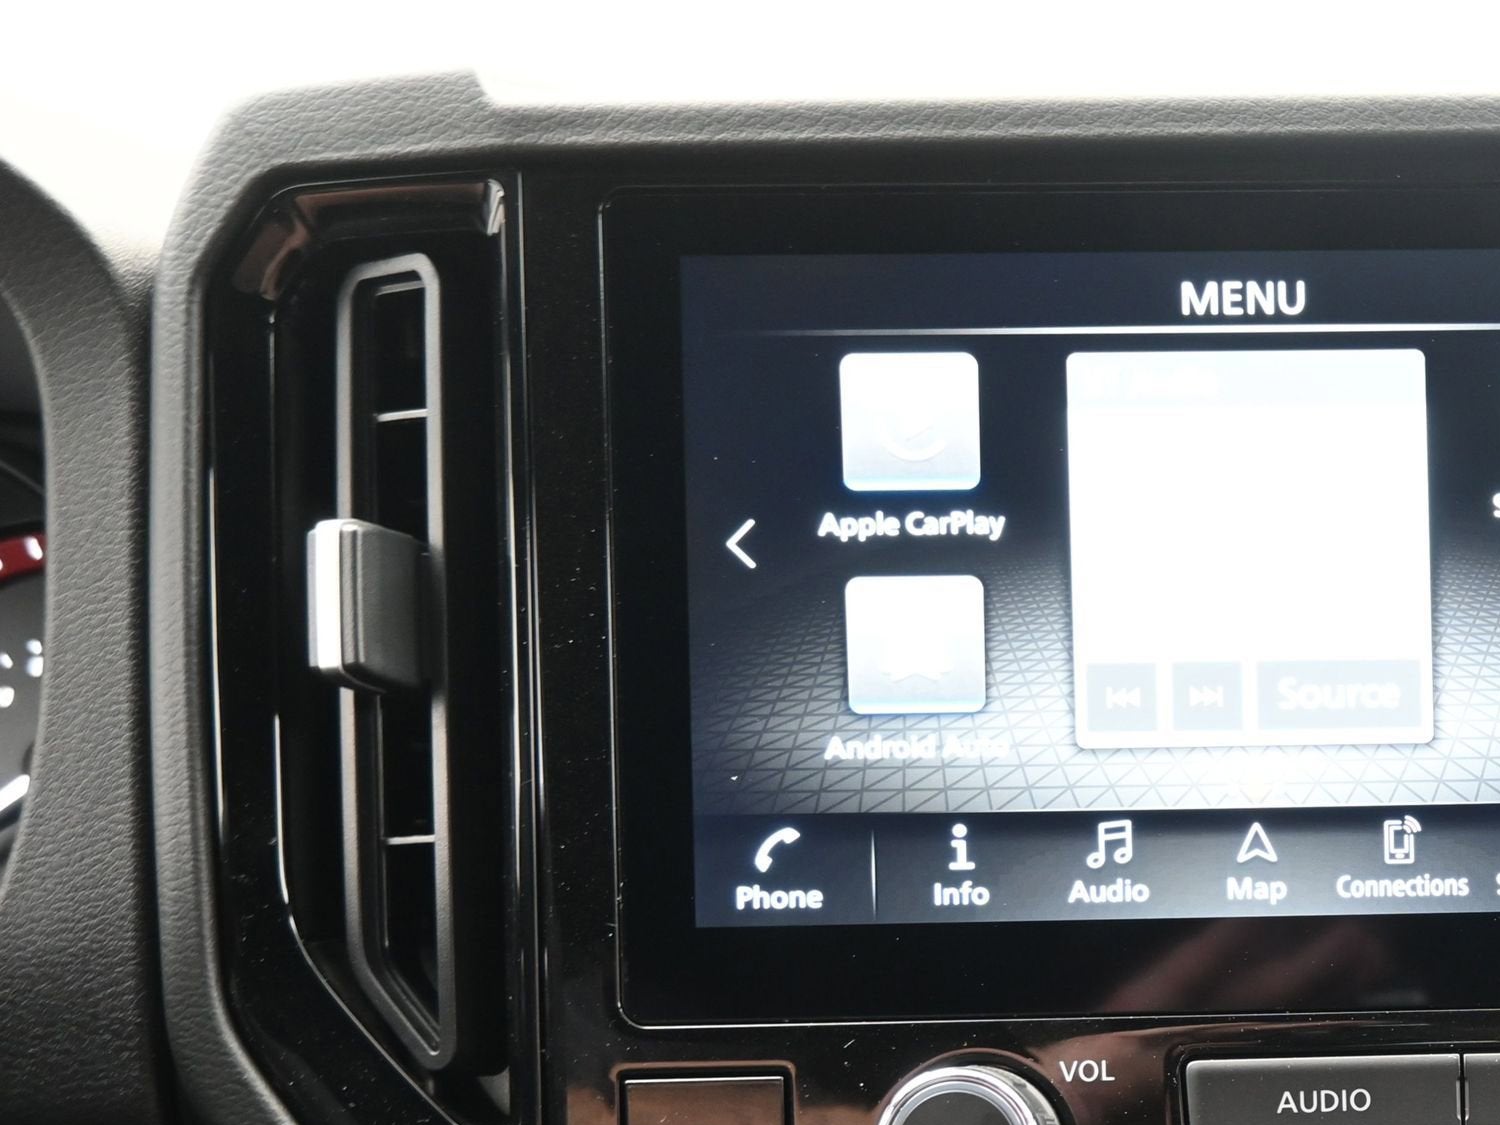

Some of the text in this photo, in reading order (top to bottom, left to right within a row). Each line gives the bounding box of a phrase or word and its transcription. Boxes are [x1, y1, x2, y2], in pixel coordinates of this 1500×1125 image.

[1180, 280, 1306, 317] MENU
[817, 509, 1006, 542] Apple CarPlay
[824, 734, 937, 761] Android
[735, 885, 824, 910] Phone
[933, 882, 990, 905] Info
[1068, 878, 1150, 904] Audio
[1226, 876, 1288, 905] Map
[1336, 874, 1469, 898] Connections
[1059, 1060, 1116, 1082] VOL
[1276, 1089, 1373, 1114] AUDIO
